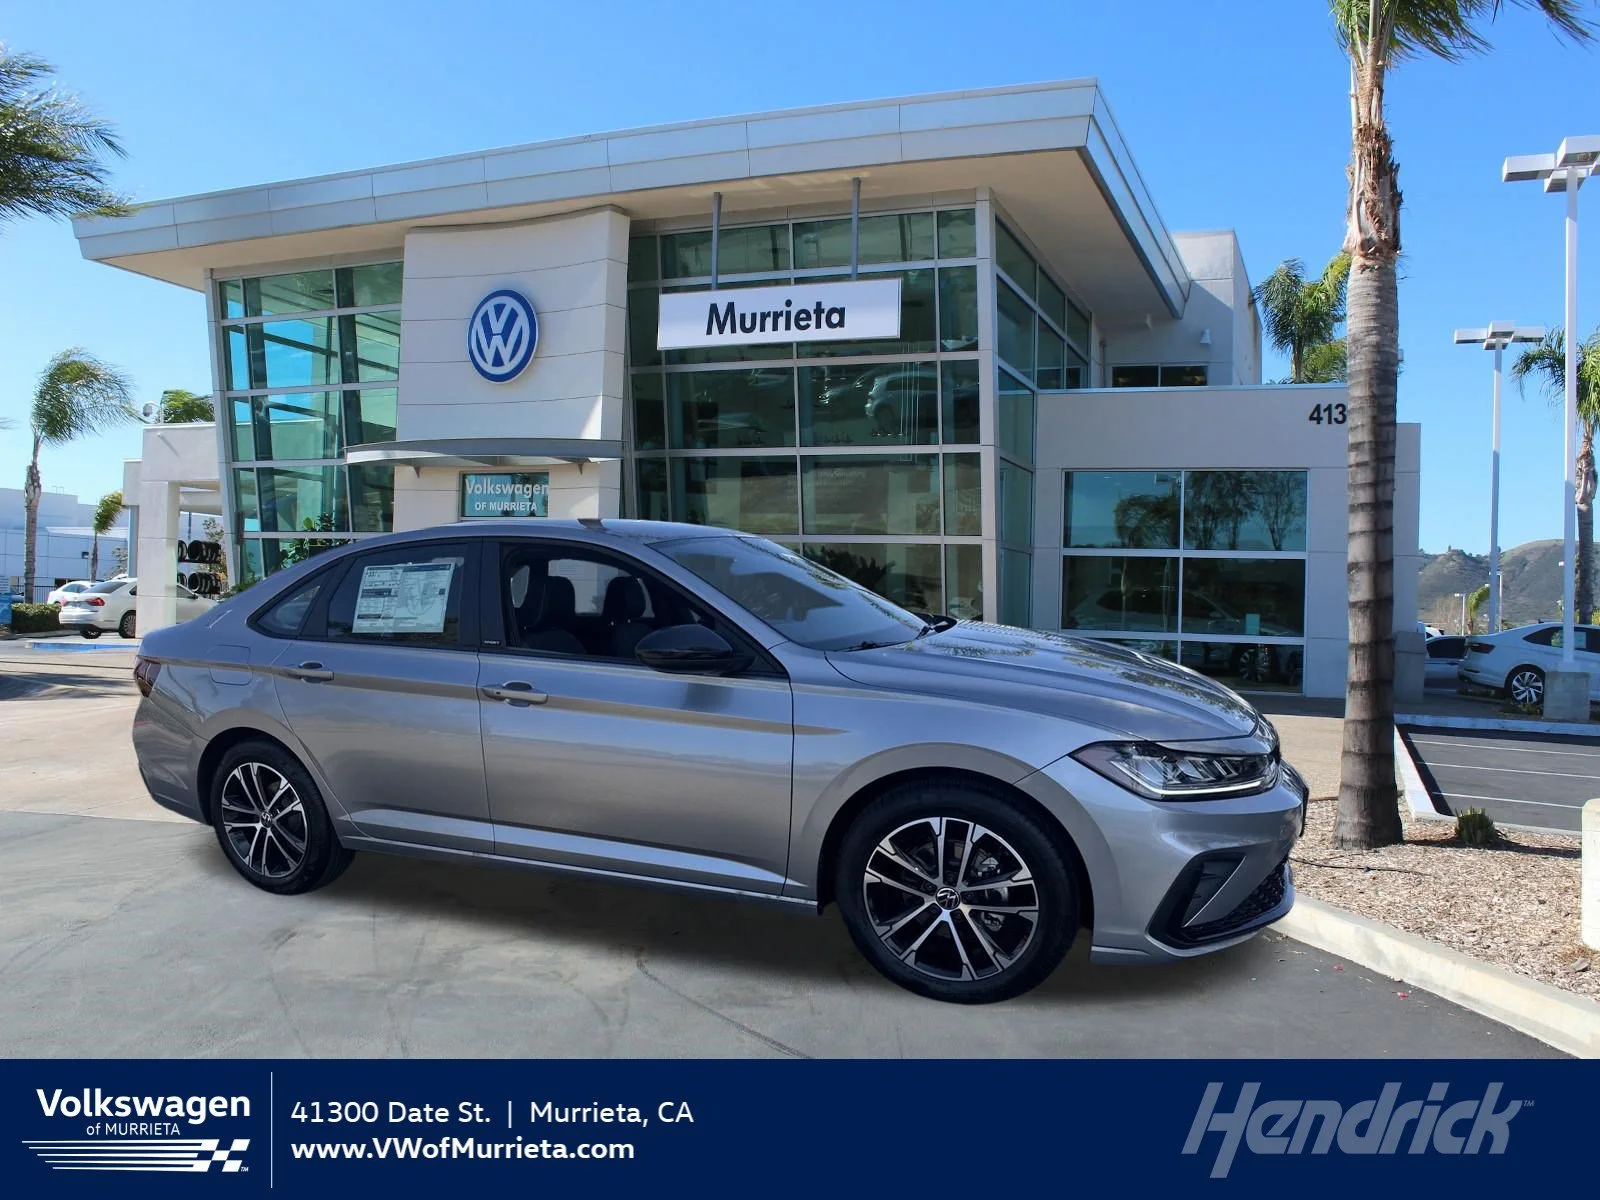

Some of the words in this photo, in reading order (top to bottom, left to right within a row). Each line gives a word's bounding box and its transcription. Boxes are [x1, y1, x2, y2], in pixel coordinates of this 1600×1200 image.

[706, 299, 846, 336] Murrieta
[464, 476, 549, 498] Volkswagen
[474, 501, 487, 511] OF
[489, 501, 538, 512] MURRIETA
